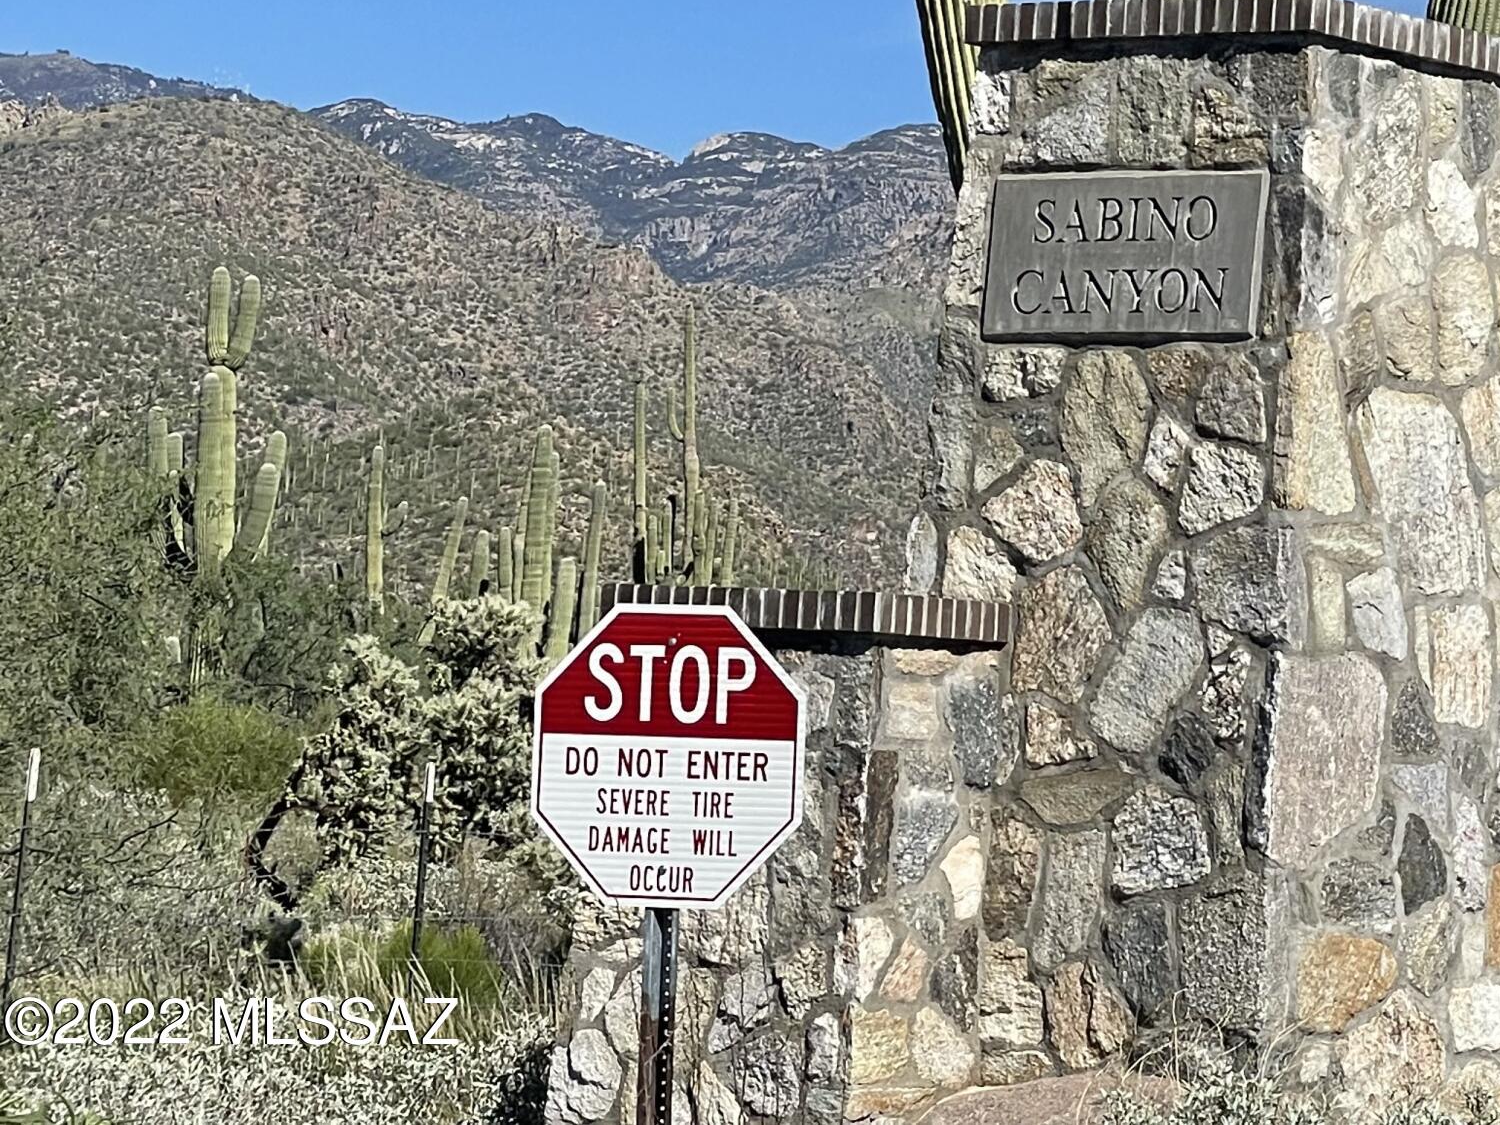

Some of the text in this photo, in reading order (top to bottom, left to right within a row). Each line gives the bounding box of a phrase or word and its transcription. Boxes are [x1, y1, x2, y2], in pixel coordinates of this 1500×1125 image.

[1033, 195, 1218, 243] SABINO
[1011, 267, 1229, 315] CANYON
[584, 642, 757, 725] STOP
[565, 747, 769, 782] DO NOT ENTER
[596, 788, 735, 819] SEVERE TIRE
[588, 826, 737, 857] DAMAGE WILL
[630, 865, 694, 893] OCCUR
